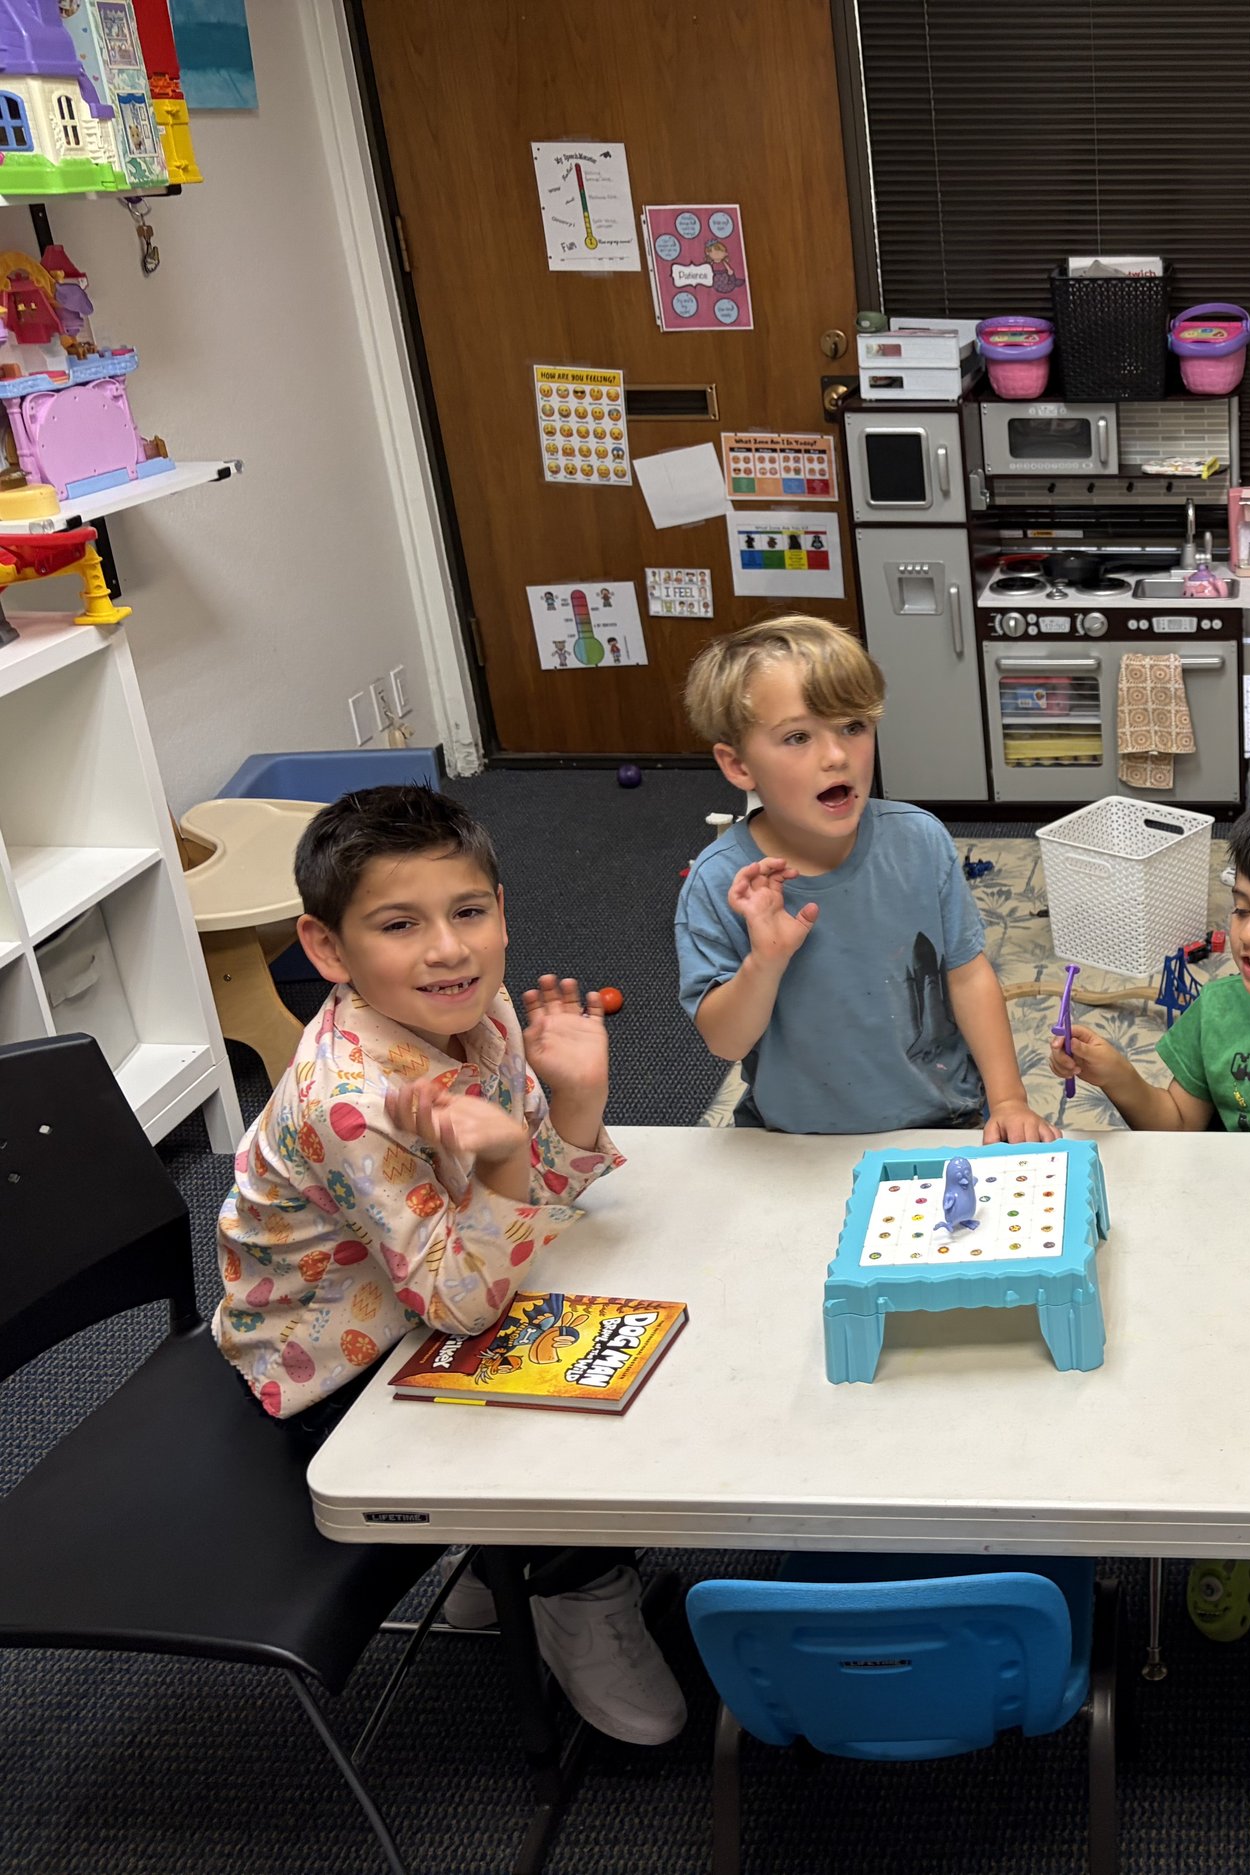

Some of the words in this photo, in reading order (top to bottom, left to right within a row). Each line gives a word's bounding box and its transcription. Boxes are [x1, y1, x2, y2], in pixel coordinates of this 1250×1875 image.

[678, 271, 708, 280] Patience
[540, 372, 556, 380] HOW
[572, 374, 584, 382] YOU
[586, 374, 616, 384] FEELING?
[664, 587, 670, 598] I
[674, 587, 695, 598] FEEL
[595, 1317, 622, 1343] BRAWL
[606, 1312, 659, 1348] DOG
[576, 1348, 632, 1388] MAN
